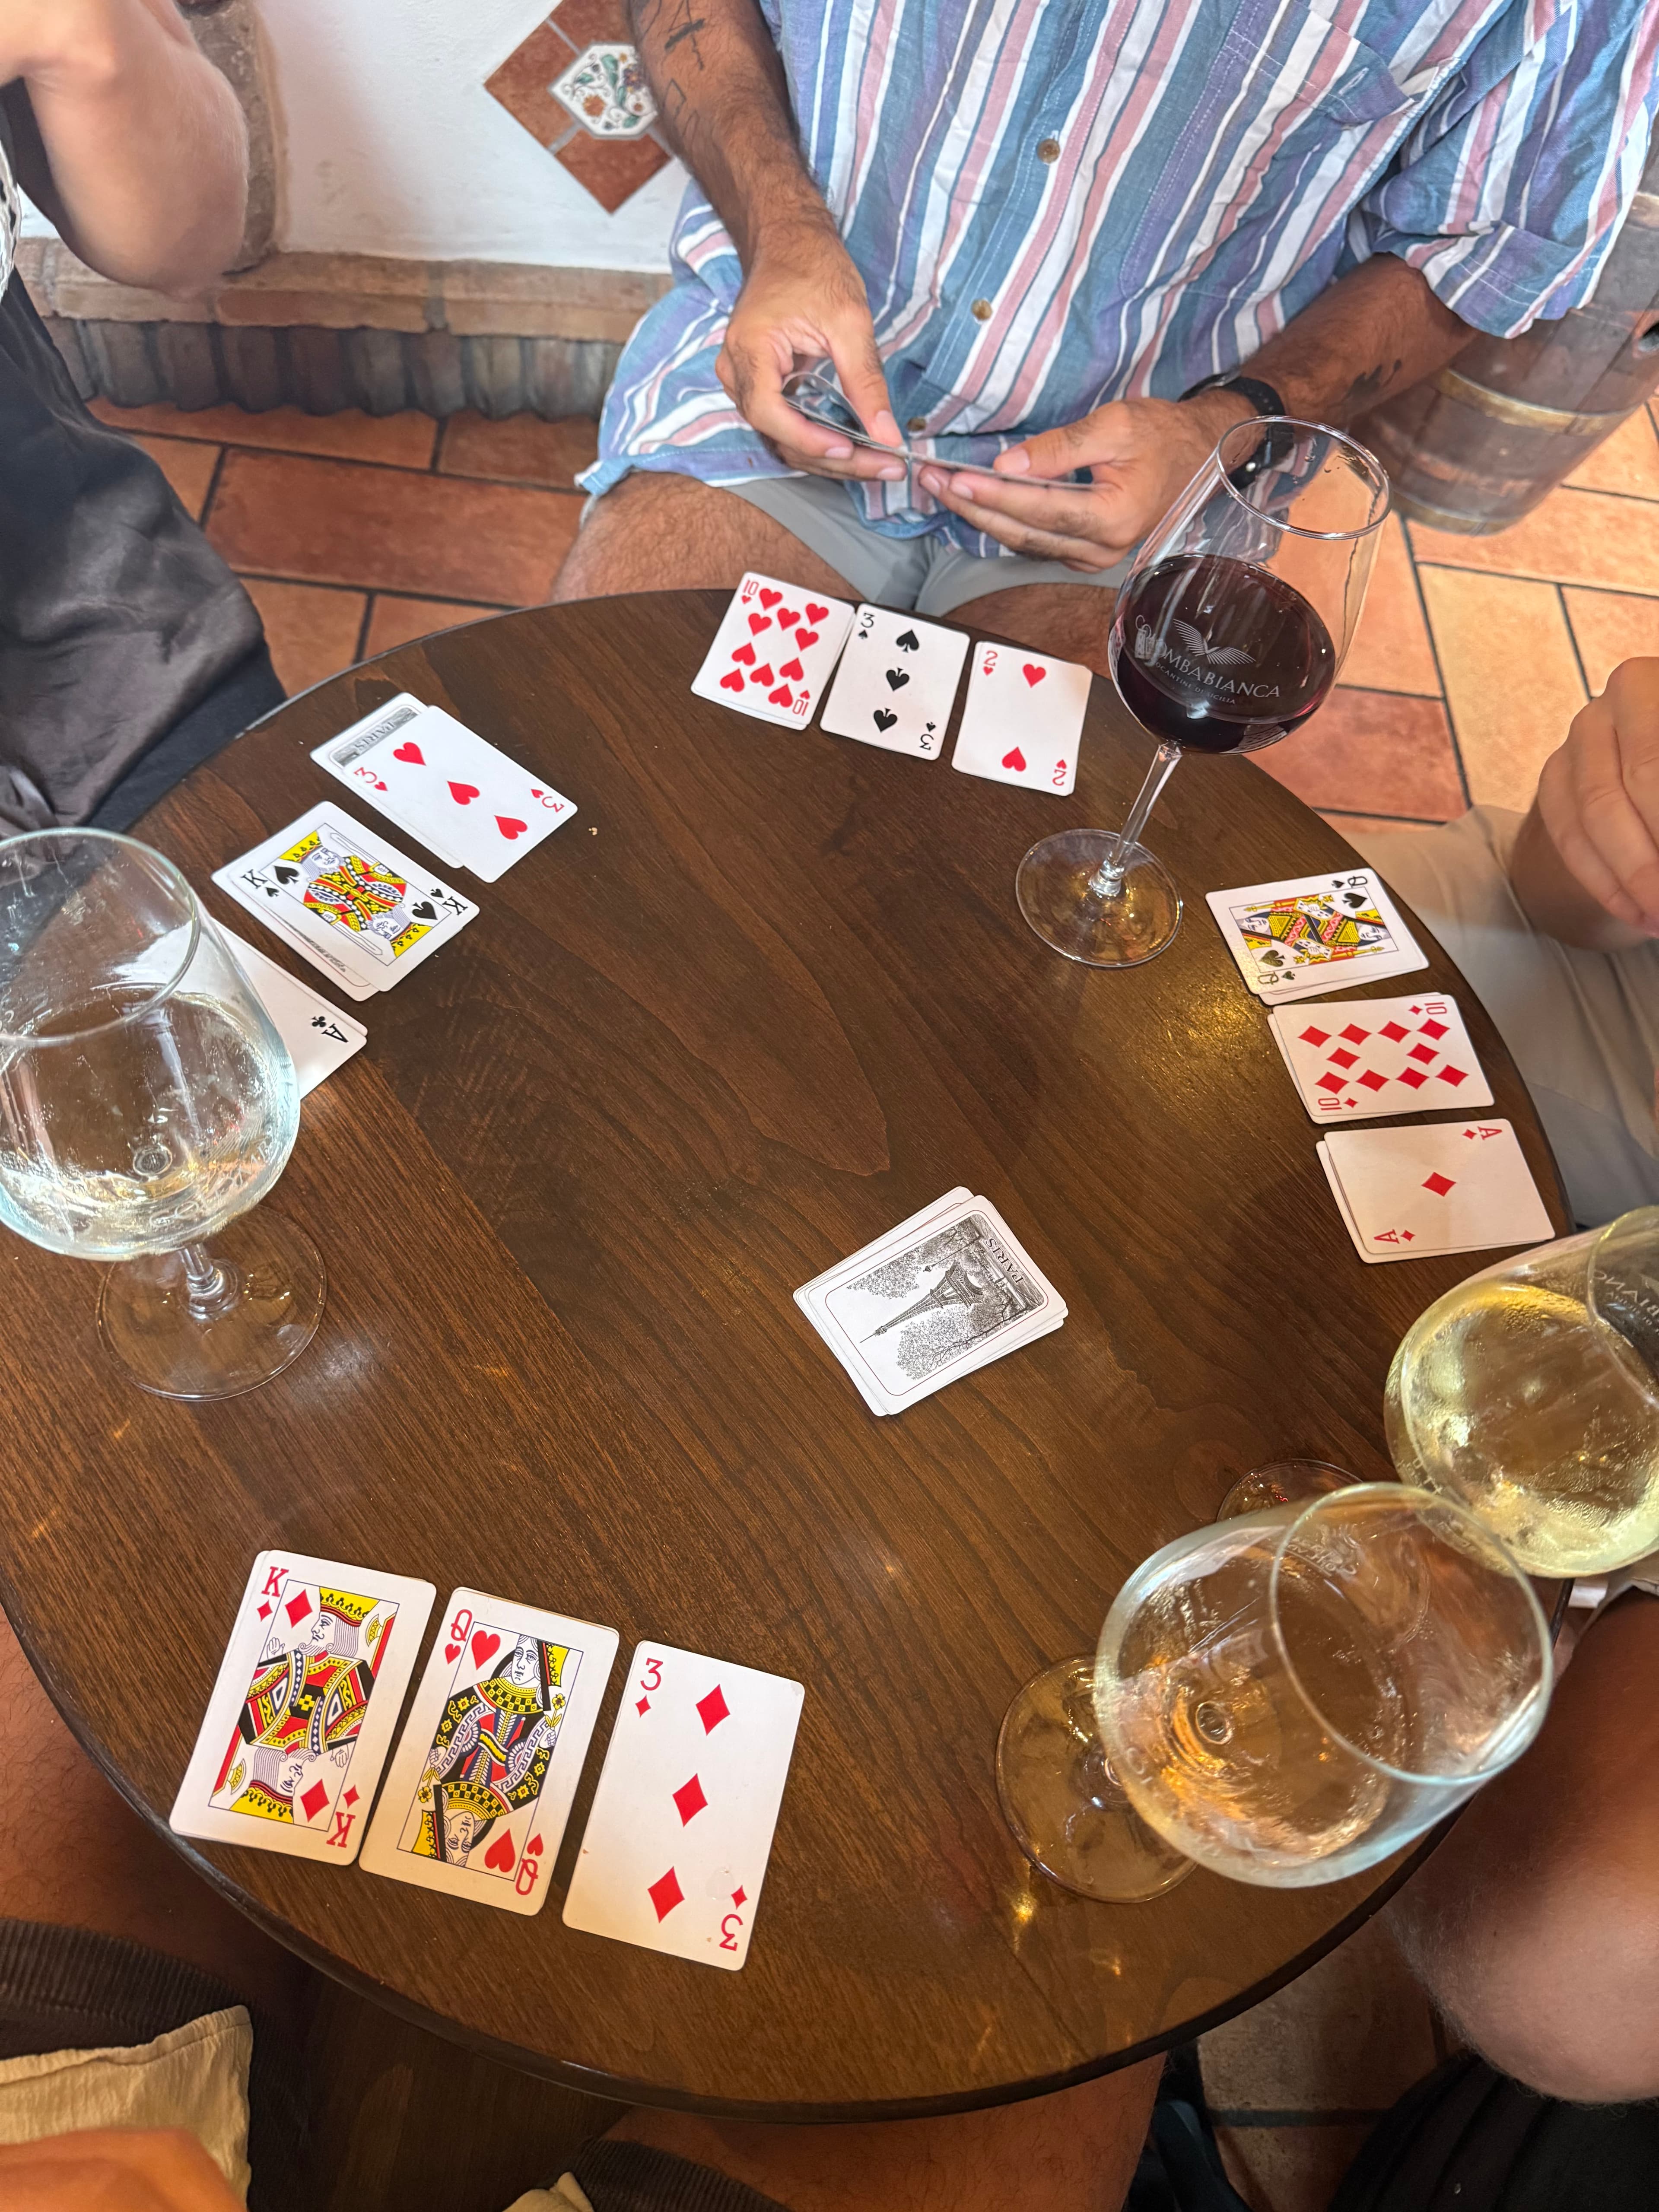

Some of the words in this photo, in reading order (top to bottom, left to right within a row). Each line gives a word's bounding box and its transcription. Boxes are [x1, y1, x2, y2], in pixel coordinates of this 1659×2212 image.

[742, 580, 759, 596] 10
[860, 612, 875, 628] 3
[983, 651, 998, 666] 2
[792, 699, 809, 716] 10
[918, 734, 934, 751] 3
[353, 767, 378, 784] 3
[1052, 771, 1066, 786] 2
[541, 797, 564, 813] 3
[241, 869, 267, 889] K
[1347, 876, 1368, 887] Q
[442, 896, 468, 915] K
[1257, 972, 1280, 985] Q
[1424, 1001, 1447, 1015] 10
[321, 1023, 348, 1043] A
[1317, 1097, 1342, 1111] 10
[1478, 1126, 1503, 1141] A
[1373, 1230, 1400, 1244] A
[985, 1238, 1024, 1283] PARIS
[261, 1566, 289, 1598] K
[450, 1608, 473, 1642] Q
[640, 1657, 663, 1691] 3
[326, 1811, 356, 1849] K
[515, 1857, 540, 1897] Q
[718, 1913, 744, 1952] 3
